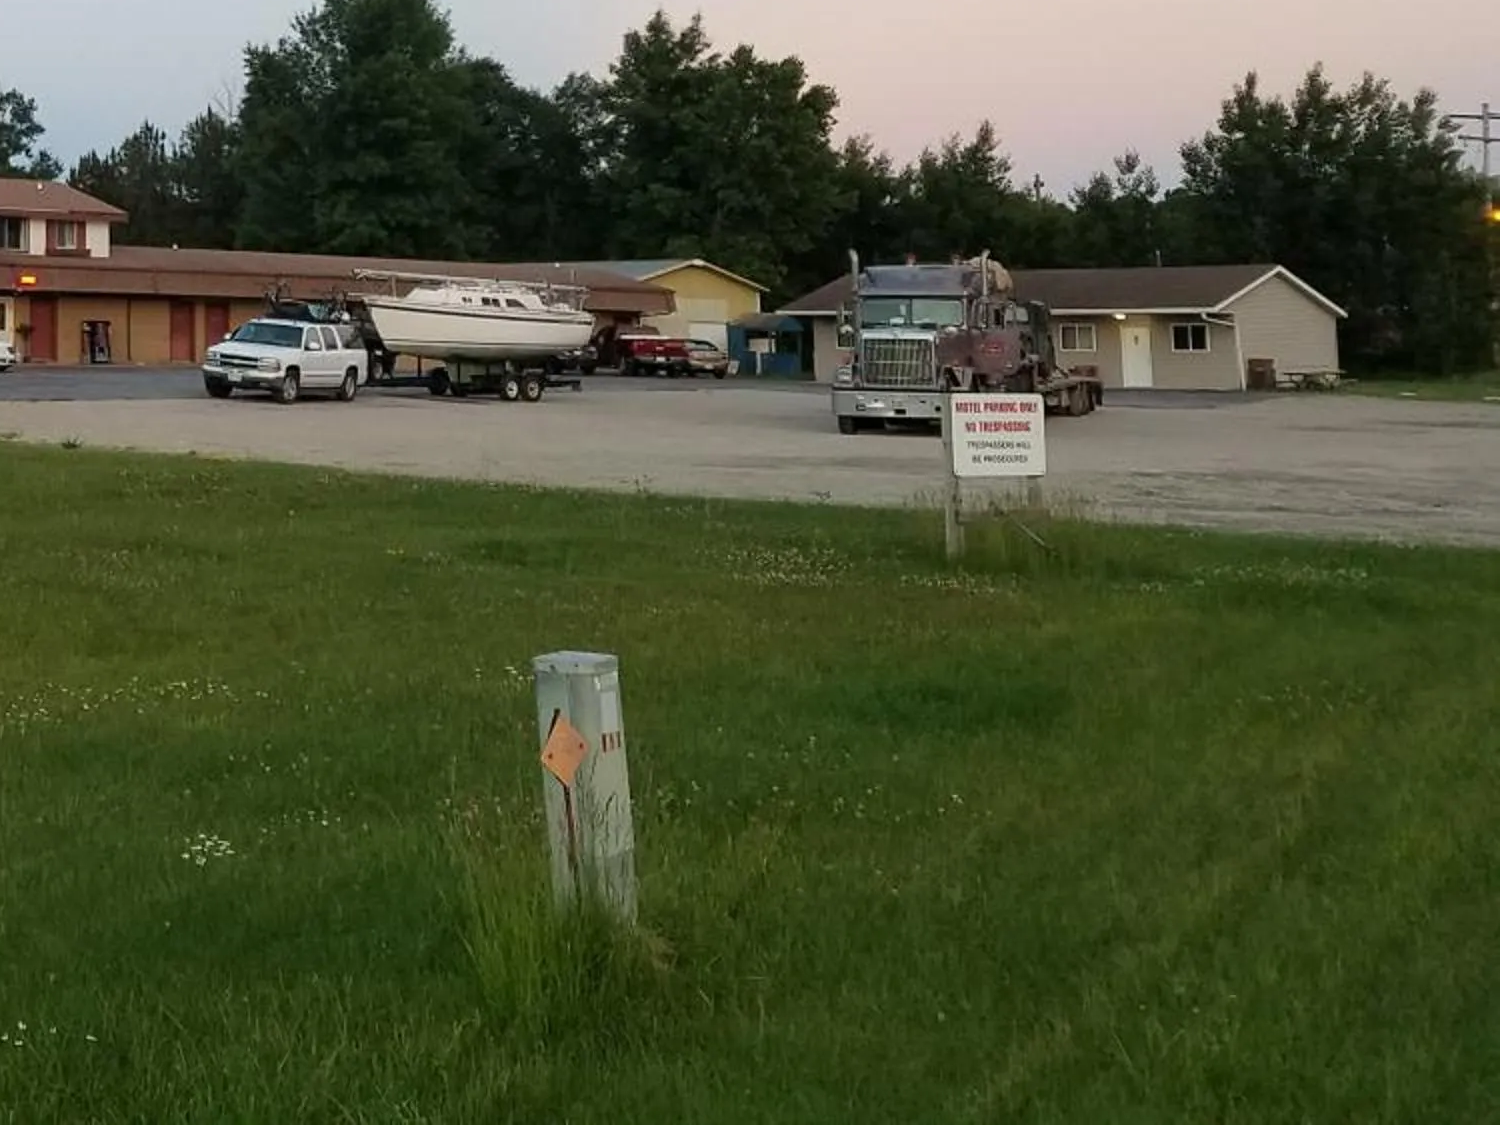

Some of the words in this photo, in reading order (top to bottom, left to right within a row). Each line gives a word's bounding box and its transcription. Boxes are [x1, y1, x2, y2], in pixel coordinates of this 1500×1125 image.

[955, 402, 982, 414] MOTEL
[983, 402, 1018, 413] PARKING
[1019, 402, 1038, 413] ONLY
[965, 422, 977, 432] NO
